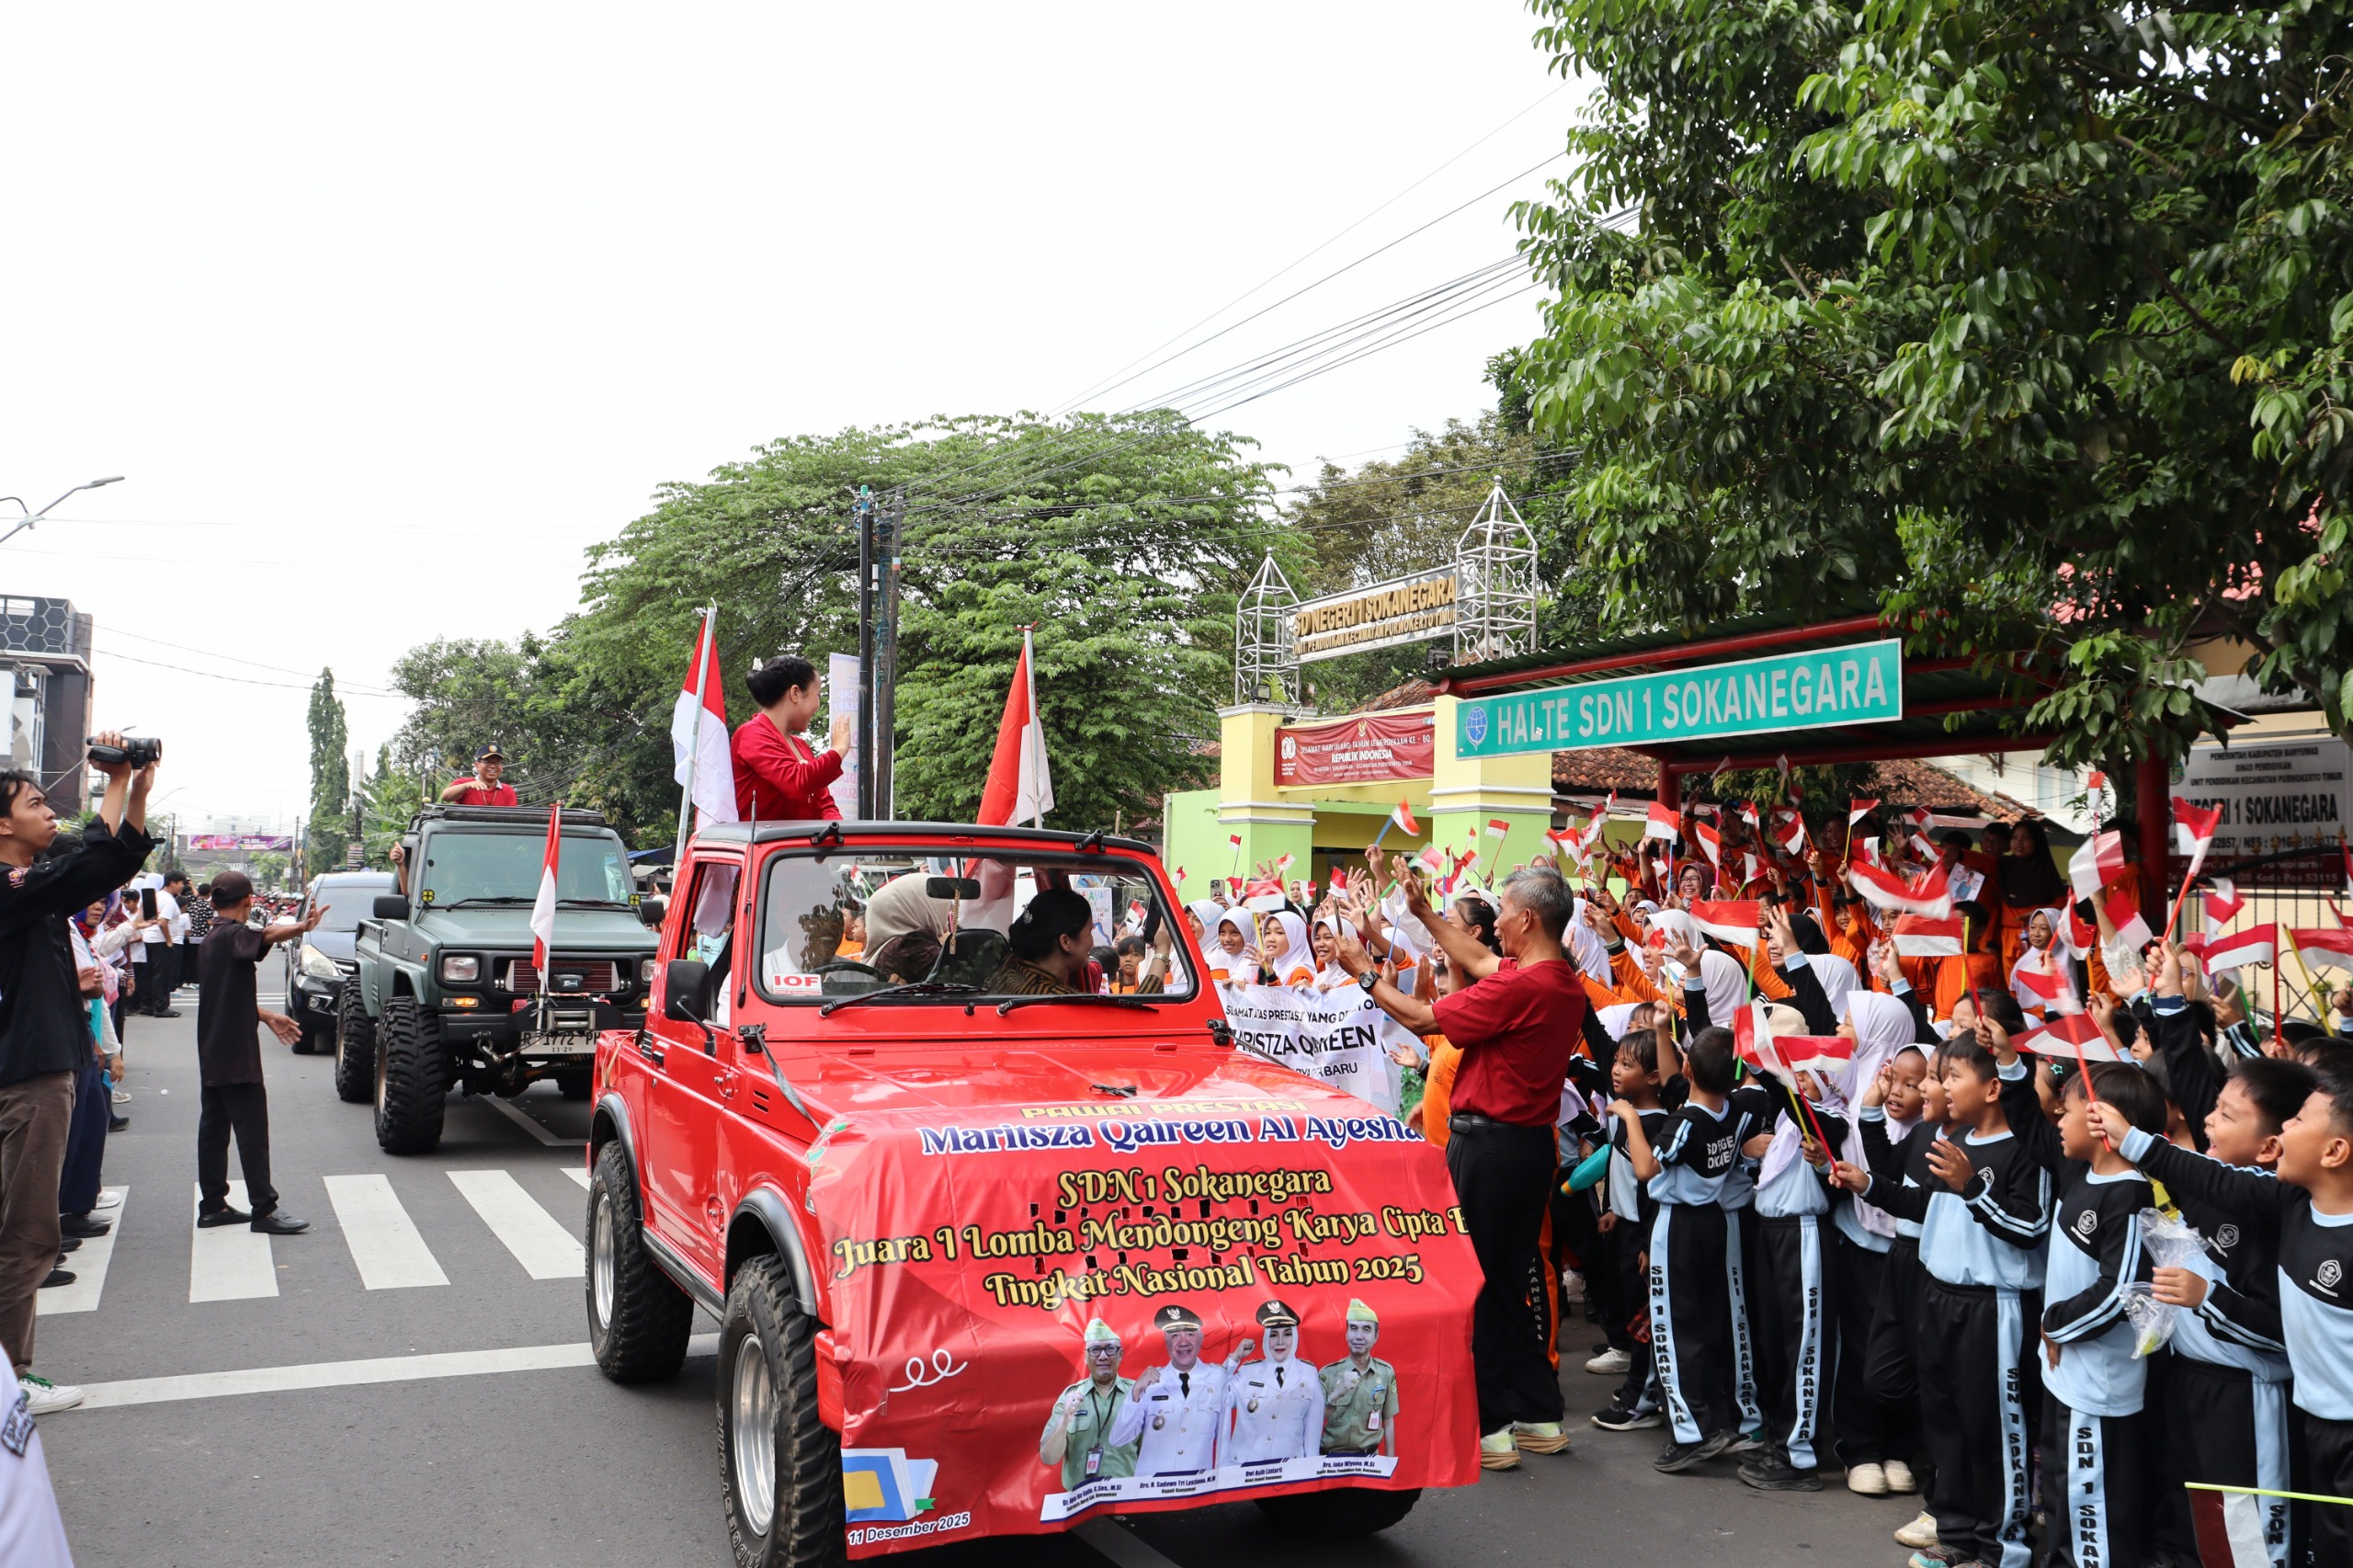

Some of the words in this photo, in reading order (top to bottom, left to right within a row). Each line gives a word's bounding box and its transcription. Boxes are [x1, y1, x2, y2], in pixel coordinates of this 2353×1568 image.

[1294, 611, 1311, 637] SD
[1311, 599, 1357, 634] NEGERI
[1364, 575, 1456, 623] SOKANEGARA
[1344, 627, 1385, 644] KECAMATAN
[1384, 616, 1435, 638] PURWOKERTO
[1497, 699, 1569, 744] HALTE
[1578, 692, 1633, 737] SDN
[1642, 687, 1652, 731] 1
[1662, 655, 1888, 730] SOKANEGARA
[1352, 740, 1370, 748] TAHUN
[2211, 751, 2247, 760] PEMERINTAH
[2248, 749, 2283, 759] KABUPATEN
[2284, 746, 2319, 756] BANYUMAS
[1331, 751, 1358, 764] REPUBLIK
[1358, 749, 1393, 762] INDONESIA
[2255, 762, 2291, 771] PENDIDIKAN
[2191, 778, 2204, 786] UNIT
[2206, 776, 2240, 786] PENDIDIKAN
[2241, 775, 2277, 785] KECAMATAN
[2279, 773, 2321, 782] PURWOKERTO
[2323, 772, 2343, 780] TIMUR
[2235, 798, 2241, 824] 1
[2245, 793, 2338, 824] SOKANEGARA
[2211, 836, 2236, 848] 02857
[774, 975, 819, 987] IOF
[1307, 1011, 1337, 1024] YANG
[542, 1032, 574, 1046] 1772
[1324, 1062, 1358, 1077] BARU
[1021, 1105, 1143, 1119] PAWAI
[1152, 1100, 1309, 1116] PRESTASI
[918, 1123, 1091, 1153] Maritsza
[1099, 1116, 1250, 1153] Qaireen
[1258, 1115, 1298, 1142] Al
[1305, 1115, 1425, 1147] Ayesha
[1059, 1169, 1142, 1208] SDN
[1144, 1177, 1155, 1199] 1
[1164, 1165, 1332, 1200] Sokanegara
[834, 1236, 931, 1278] Juara
[937, 1227, 957, 1260] I
[963, 1221, 1074, 1258] Lomba
[1081, 1212, 1279, 1251] Mendongeng
[1285, 1209, 1377, 1244] Karya
[1381, 1205, 1446, 1242] Cipta
[984, 1267, 1108, 1309] Tingkat
[1114, 1257, 1254, 1295] Nasional
[1257, 1254, 1348, 1286] Tahun
[1354, 1255, 1424, 1284] 2025
[1651, 1265, 1665, 1297] SDN
[1654, 1305, 1664, 1316] 1
[1739, 1305, 1745, 1315] 1
[1809, 1288, 1818, 1319] SDN
[1811, 1327, 1815, 1338] 1
[1737, 1322, 1757, 1416] SOKANEGARA
[1799, 1346, 1815, 1440] SOKANEGAR
[2006, 1368, 2020, 1404] SDN
[2008, 1413, 2019, 1425] 1
[2076, 1426, 2095, 1469] SDN
[2081, 1482, 2094, 1494] 1
[848, 1530, 863, 1544] 11
[867, 1521, 936, 1541] Desember
[938, 1513, 970, 1530] 2025
[2268, 1505, 2286, 1544] SDN
